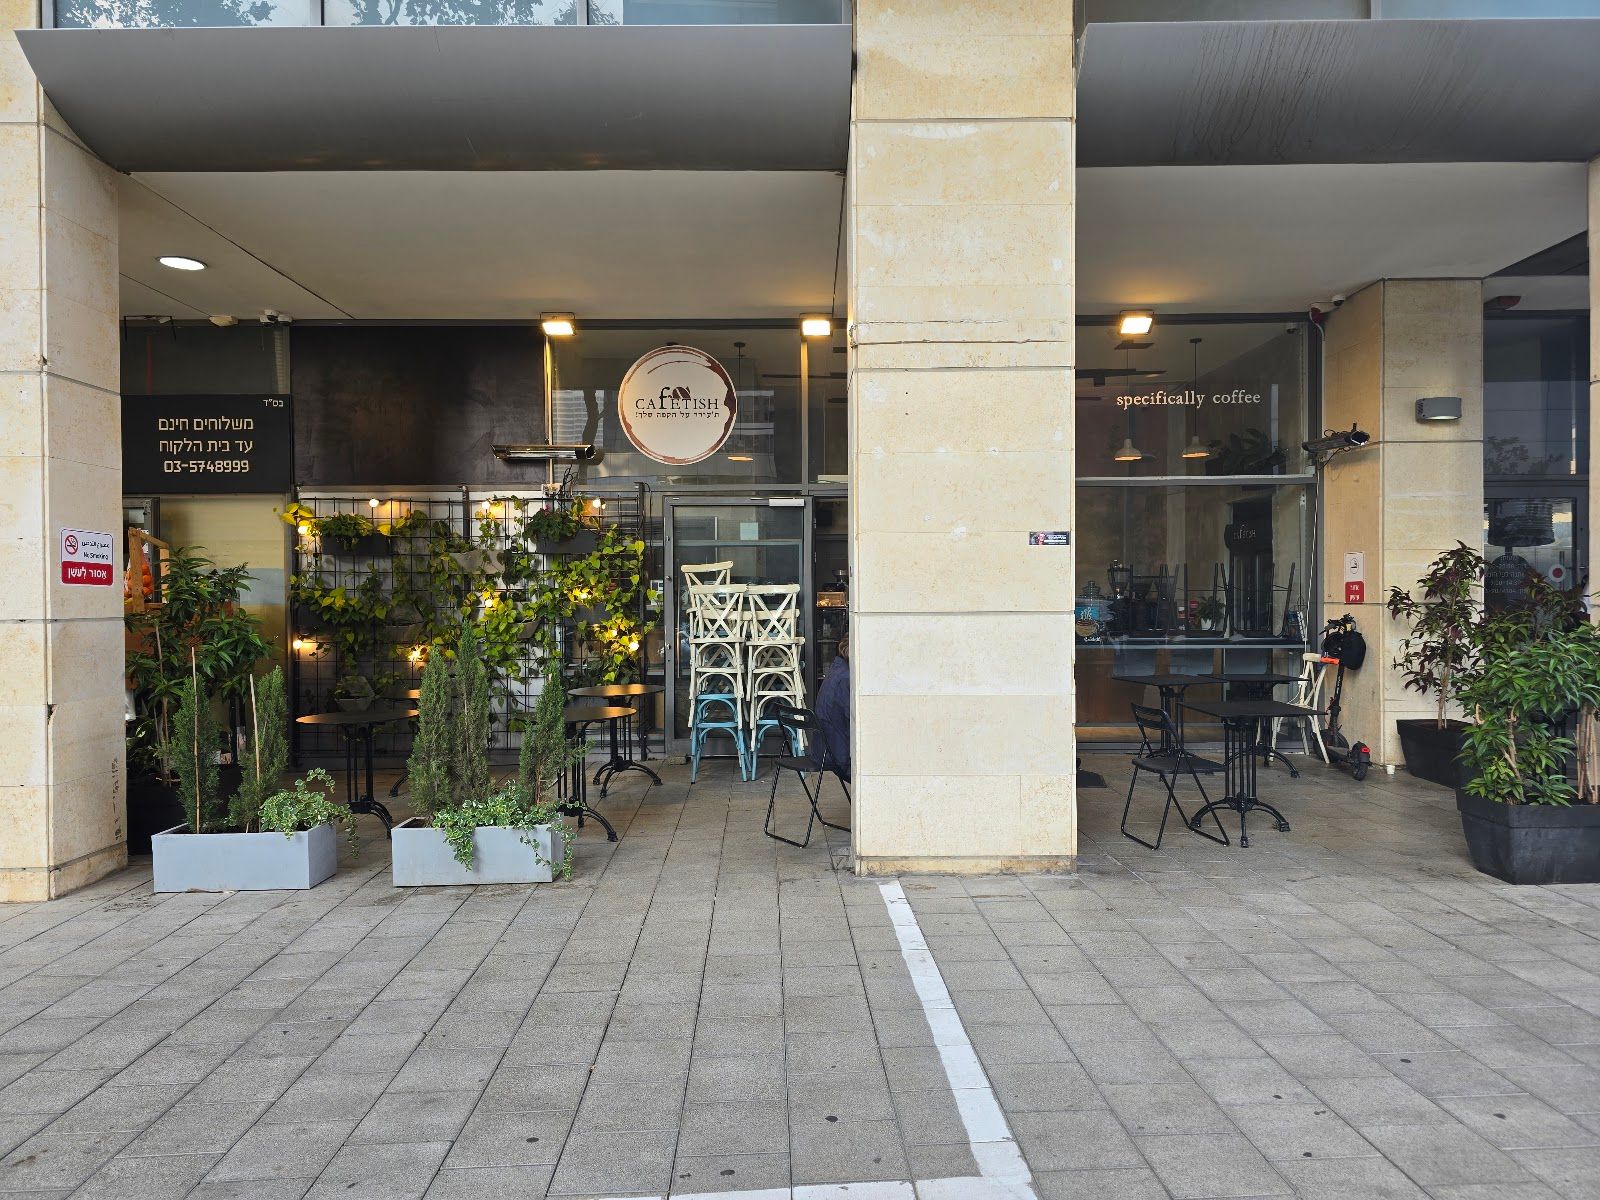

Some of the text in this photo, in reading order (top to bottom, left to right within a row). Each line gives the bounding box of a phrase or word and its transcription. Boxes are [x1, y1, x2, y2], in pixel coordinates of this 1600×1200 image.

[262, 398, 284, 407] בס"ד
[1116, 390, 1261, 410] specifically coffee
[679, 410, 690, 419] על
[158, 415, 254, 431] משלוחים חינם
[159, 437, 253, 455] עד בית הלקוח
[163, 460, 250, 473] 03-5748999
[68, 566, 107, 580] אסור לעשן
